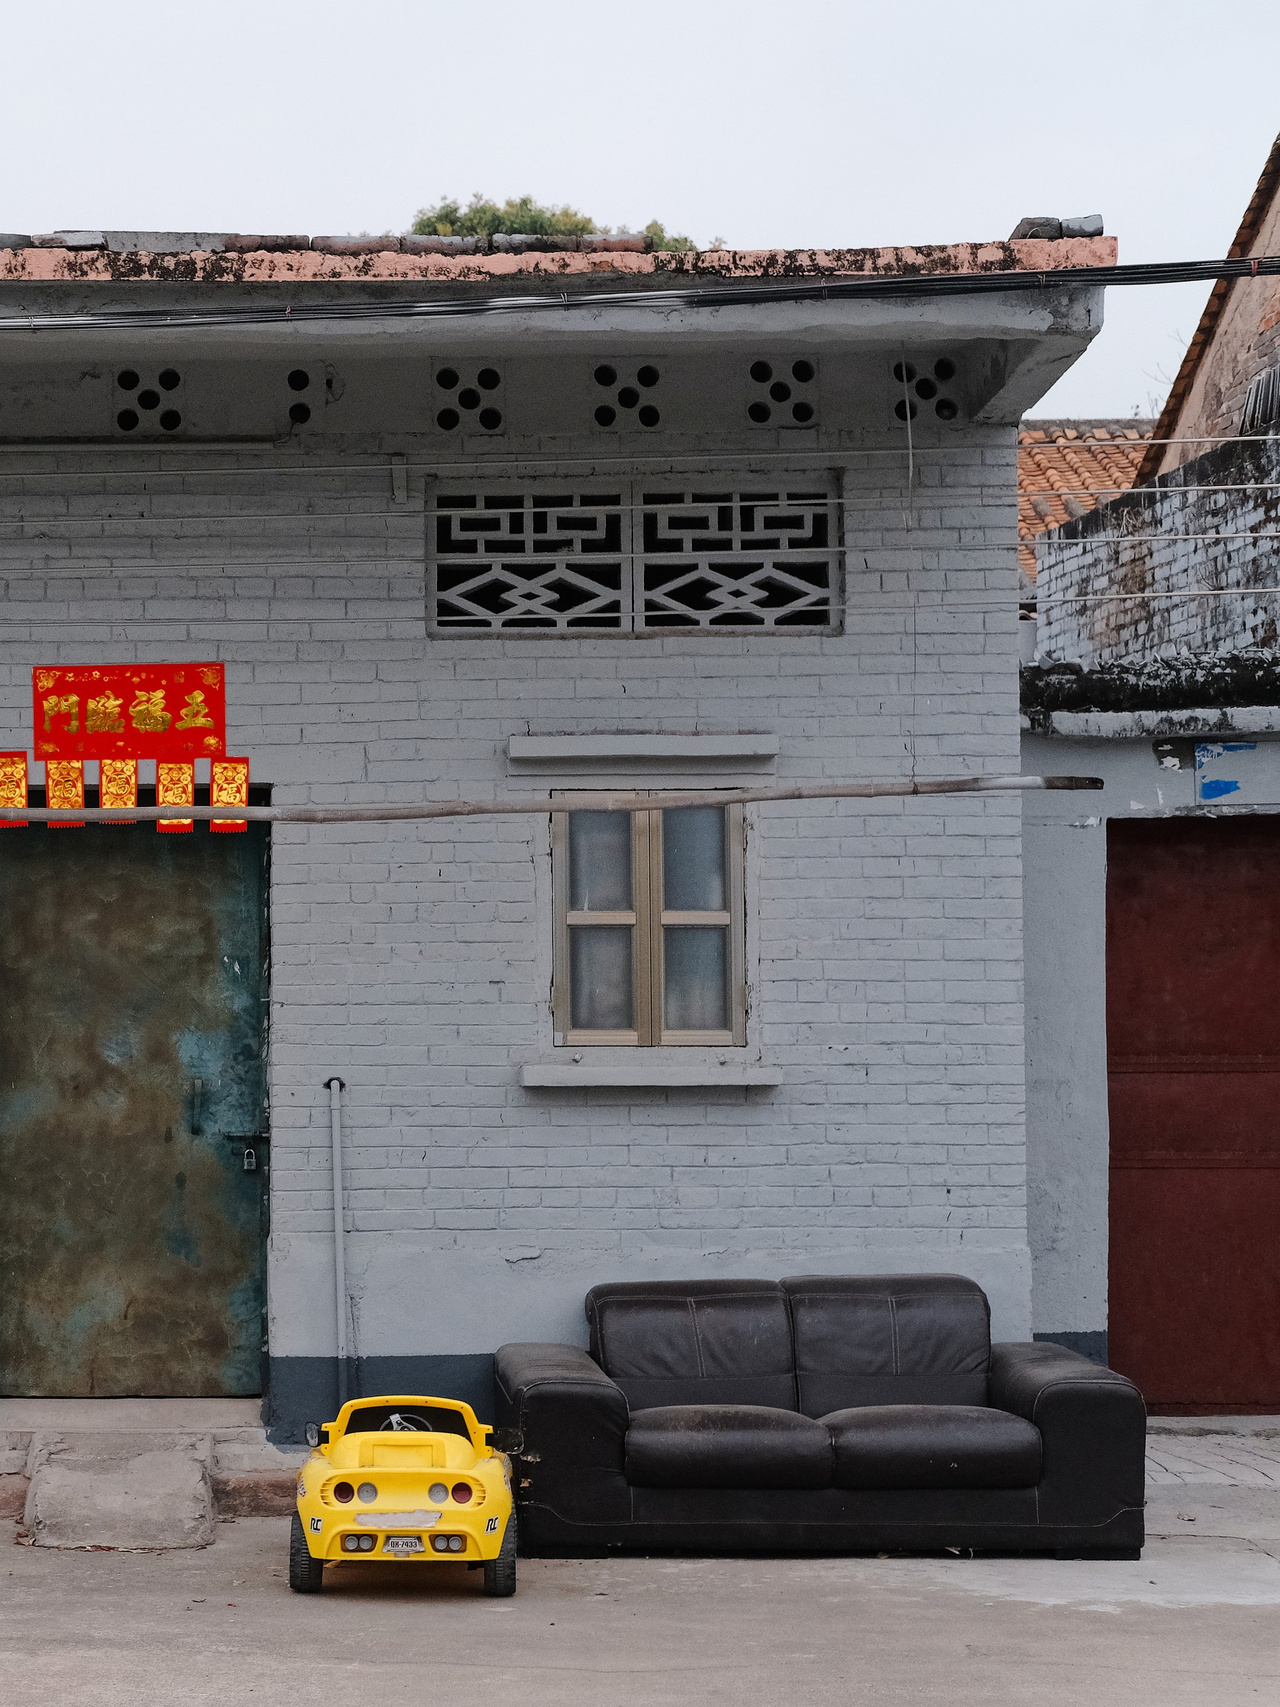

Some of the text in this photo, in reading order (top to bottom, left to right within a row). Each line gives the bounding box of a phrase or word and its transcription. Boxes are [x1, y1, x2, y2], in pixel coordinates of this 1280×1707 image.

[54, 779, 76, 798] 福
[107, 775, 129, 795] 福
[163, 784, 186, 804] 福
[219, 784, 241, 804] 福
